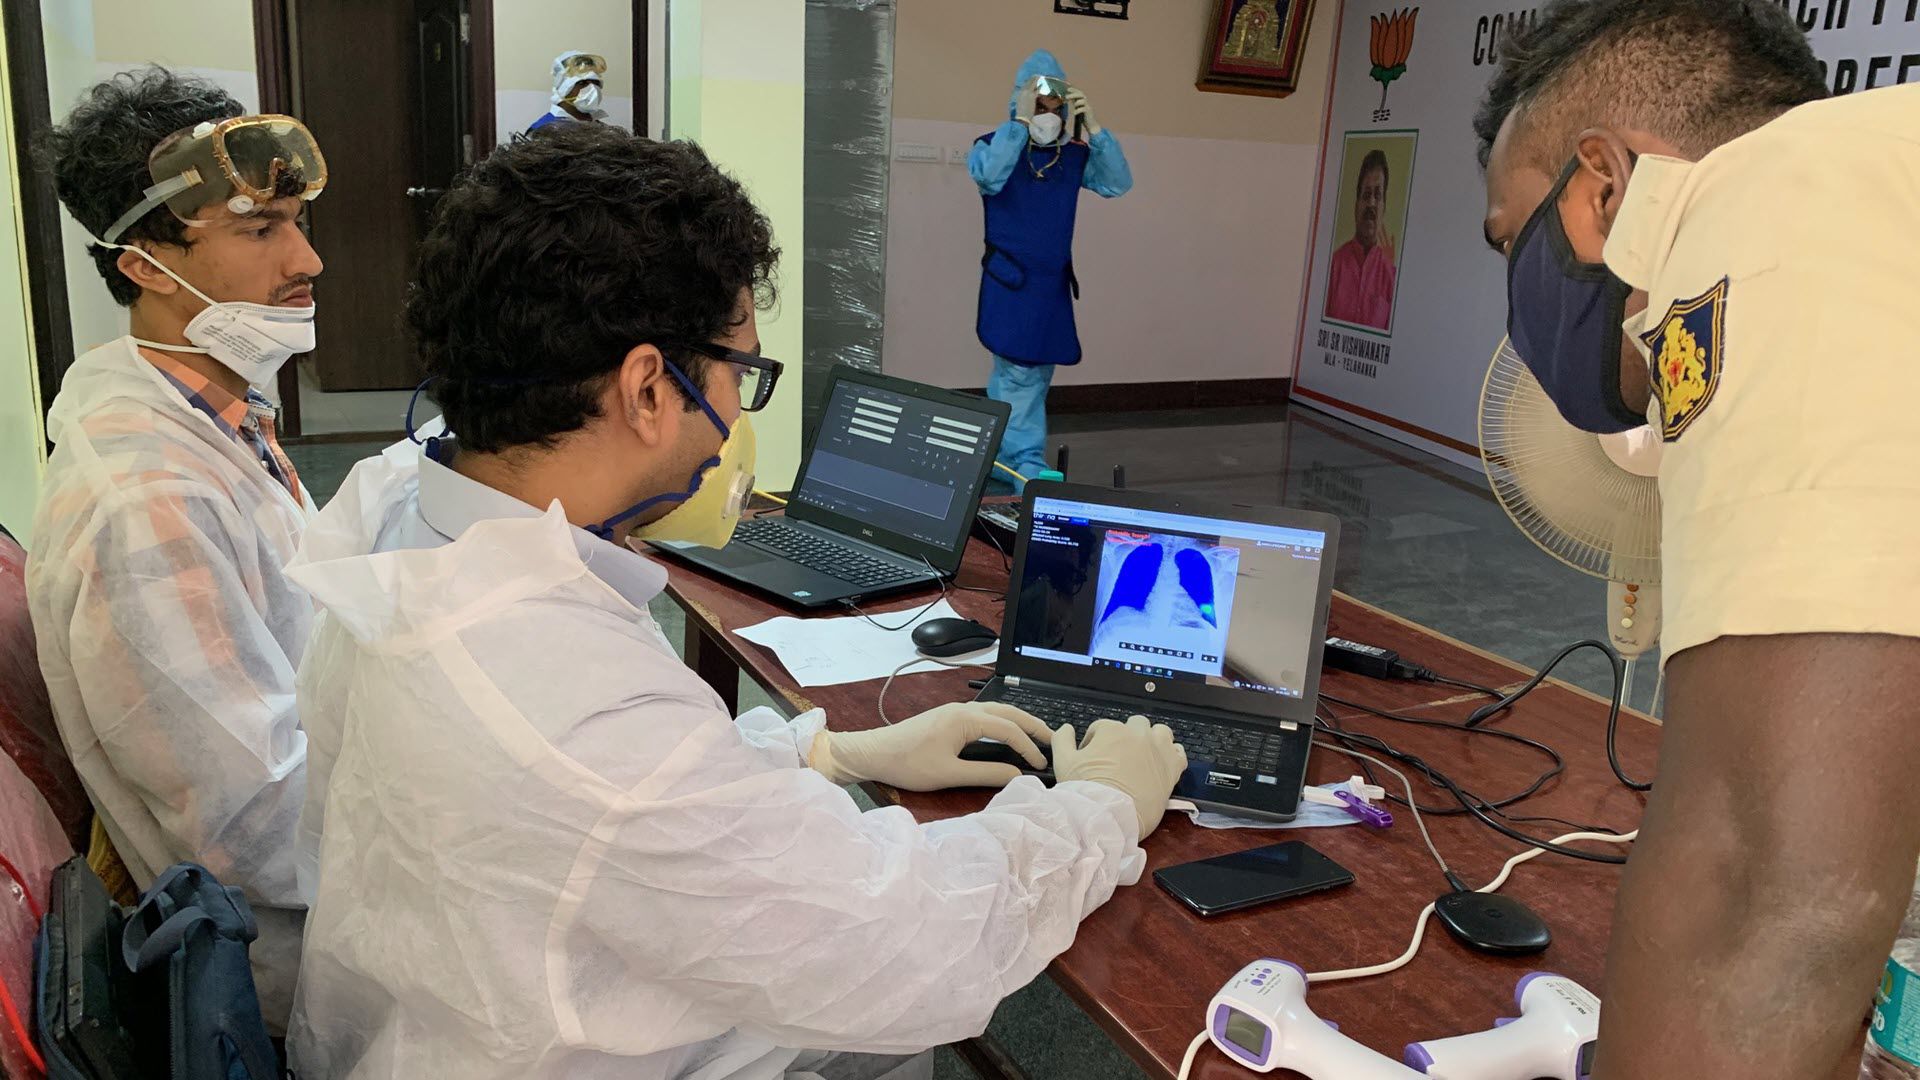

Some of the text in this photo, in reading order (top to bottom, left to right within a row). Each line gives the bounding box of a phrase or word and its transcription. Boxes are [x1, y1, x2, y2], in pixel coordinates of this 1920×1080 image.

[1317, 329, 1391, 365] SRI SR VISHWANATH
[1323, 352, 1336, 367] MLA
[1342, 357, 1377, 379] YELAHANKA
